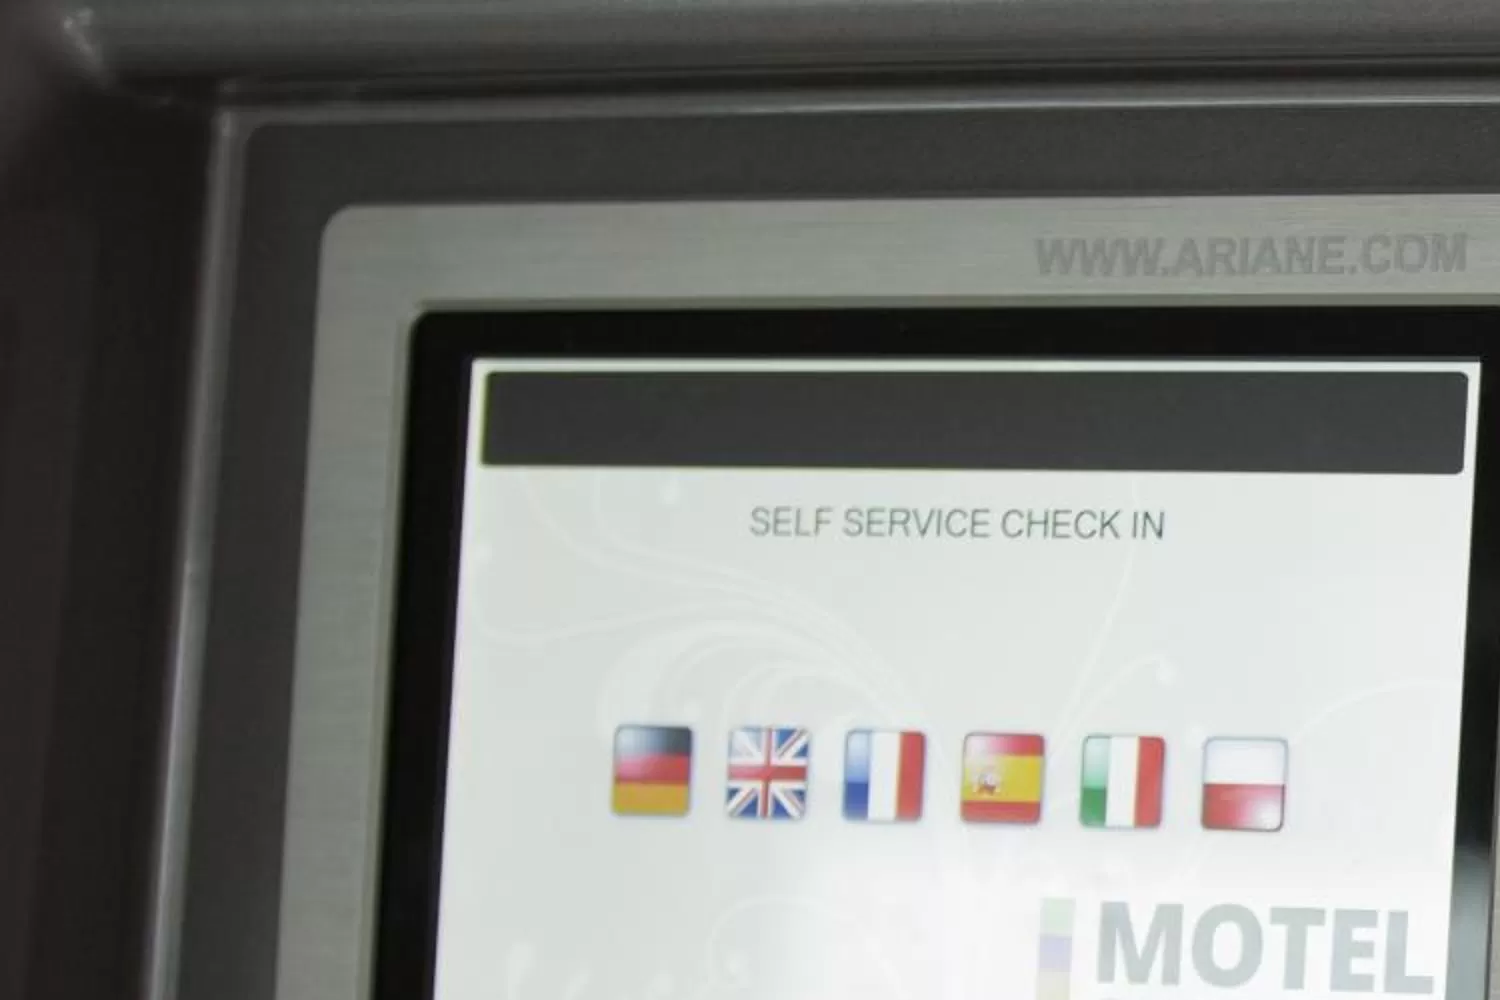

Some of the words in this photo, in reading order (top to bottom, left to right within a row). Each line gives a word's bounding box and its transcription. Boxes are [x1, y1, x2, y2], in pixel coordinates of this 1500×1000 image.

[1034, 233, 1468, 277] WWW.ARIANE.COM
[749, 505, 832, 537] SELF
[842, 507, 991, 538] SERVICE
[1000, 509, 1121, 539] CHECK
[1132, 511, 1165, 540] IN
[1096, 901, 1435, 995] MOTEL
